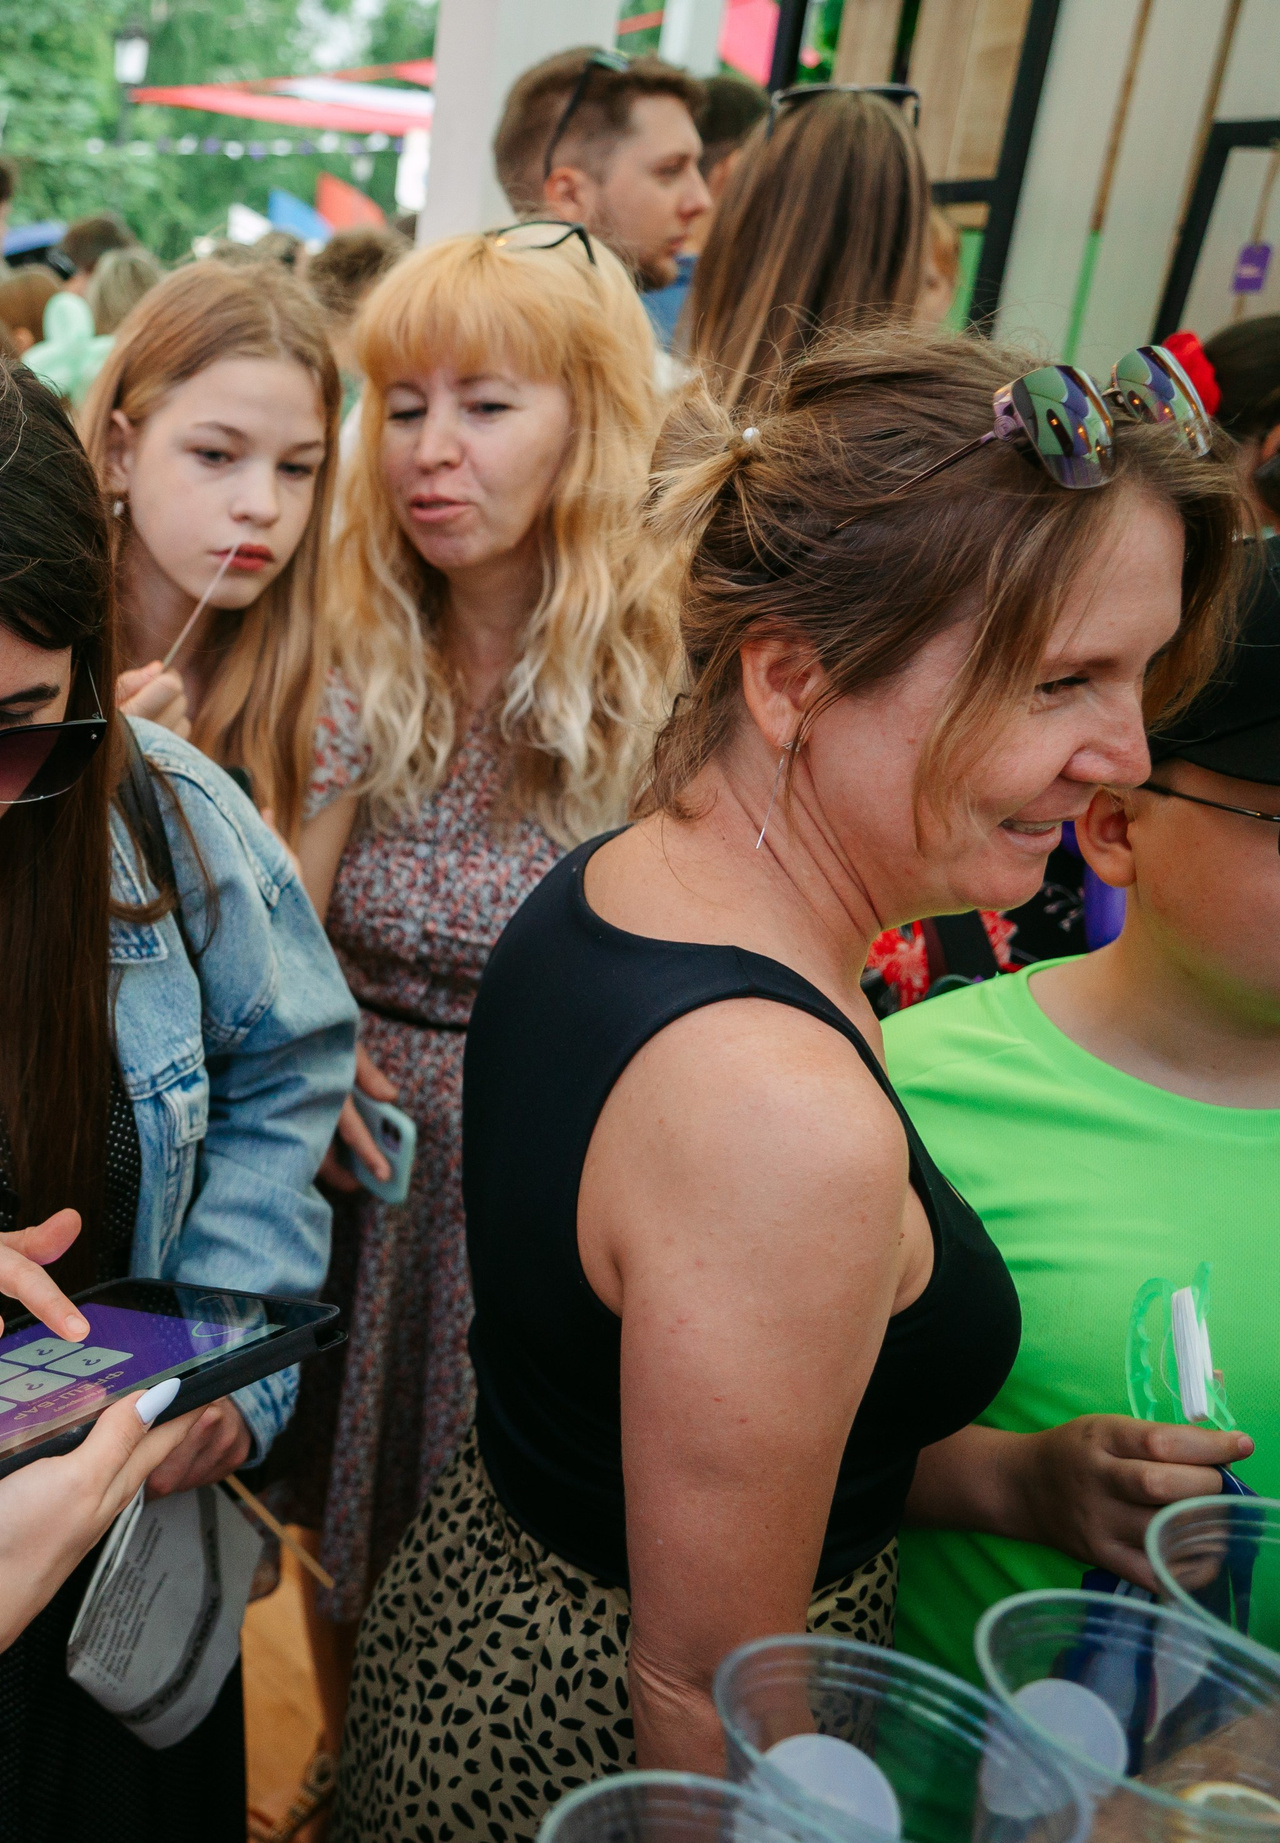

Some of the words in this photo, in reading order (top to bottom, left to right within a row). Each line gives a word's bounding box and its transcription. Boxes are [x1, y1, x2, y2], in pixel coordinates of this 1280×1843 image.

[37, 1346, 54, 1356] ?
[82, 1356, 102, 1367] ?
[25, 1382, 44, 1391] ?
[14, 1371, 124, 1420] ФРЕШ-БАР
